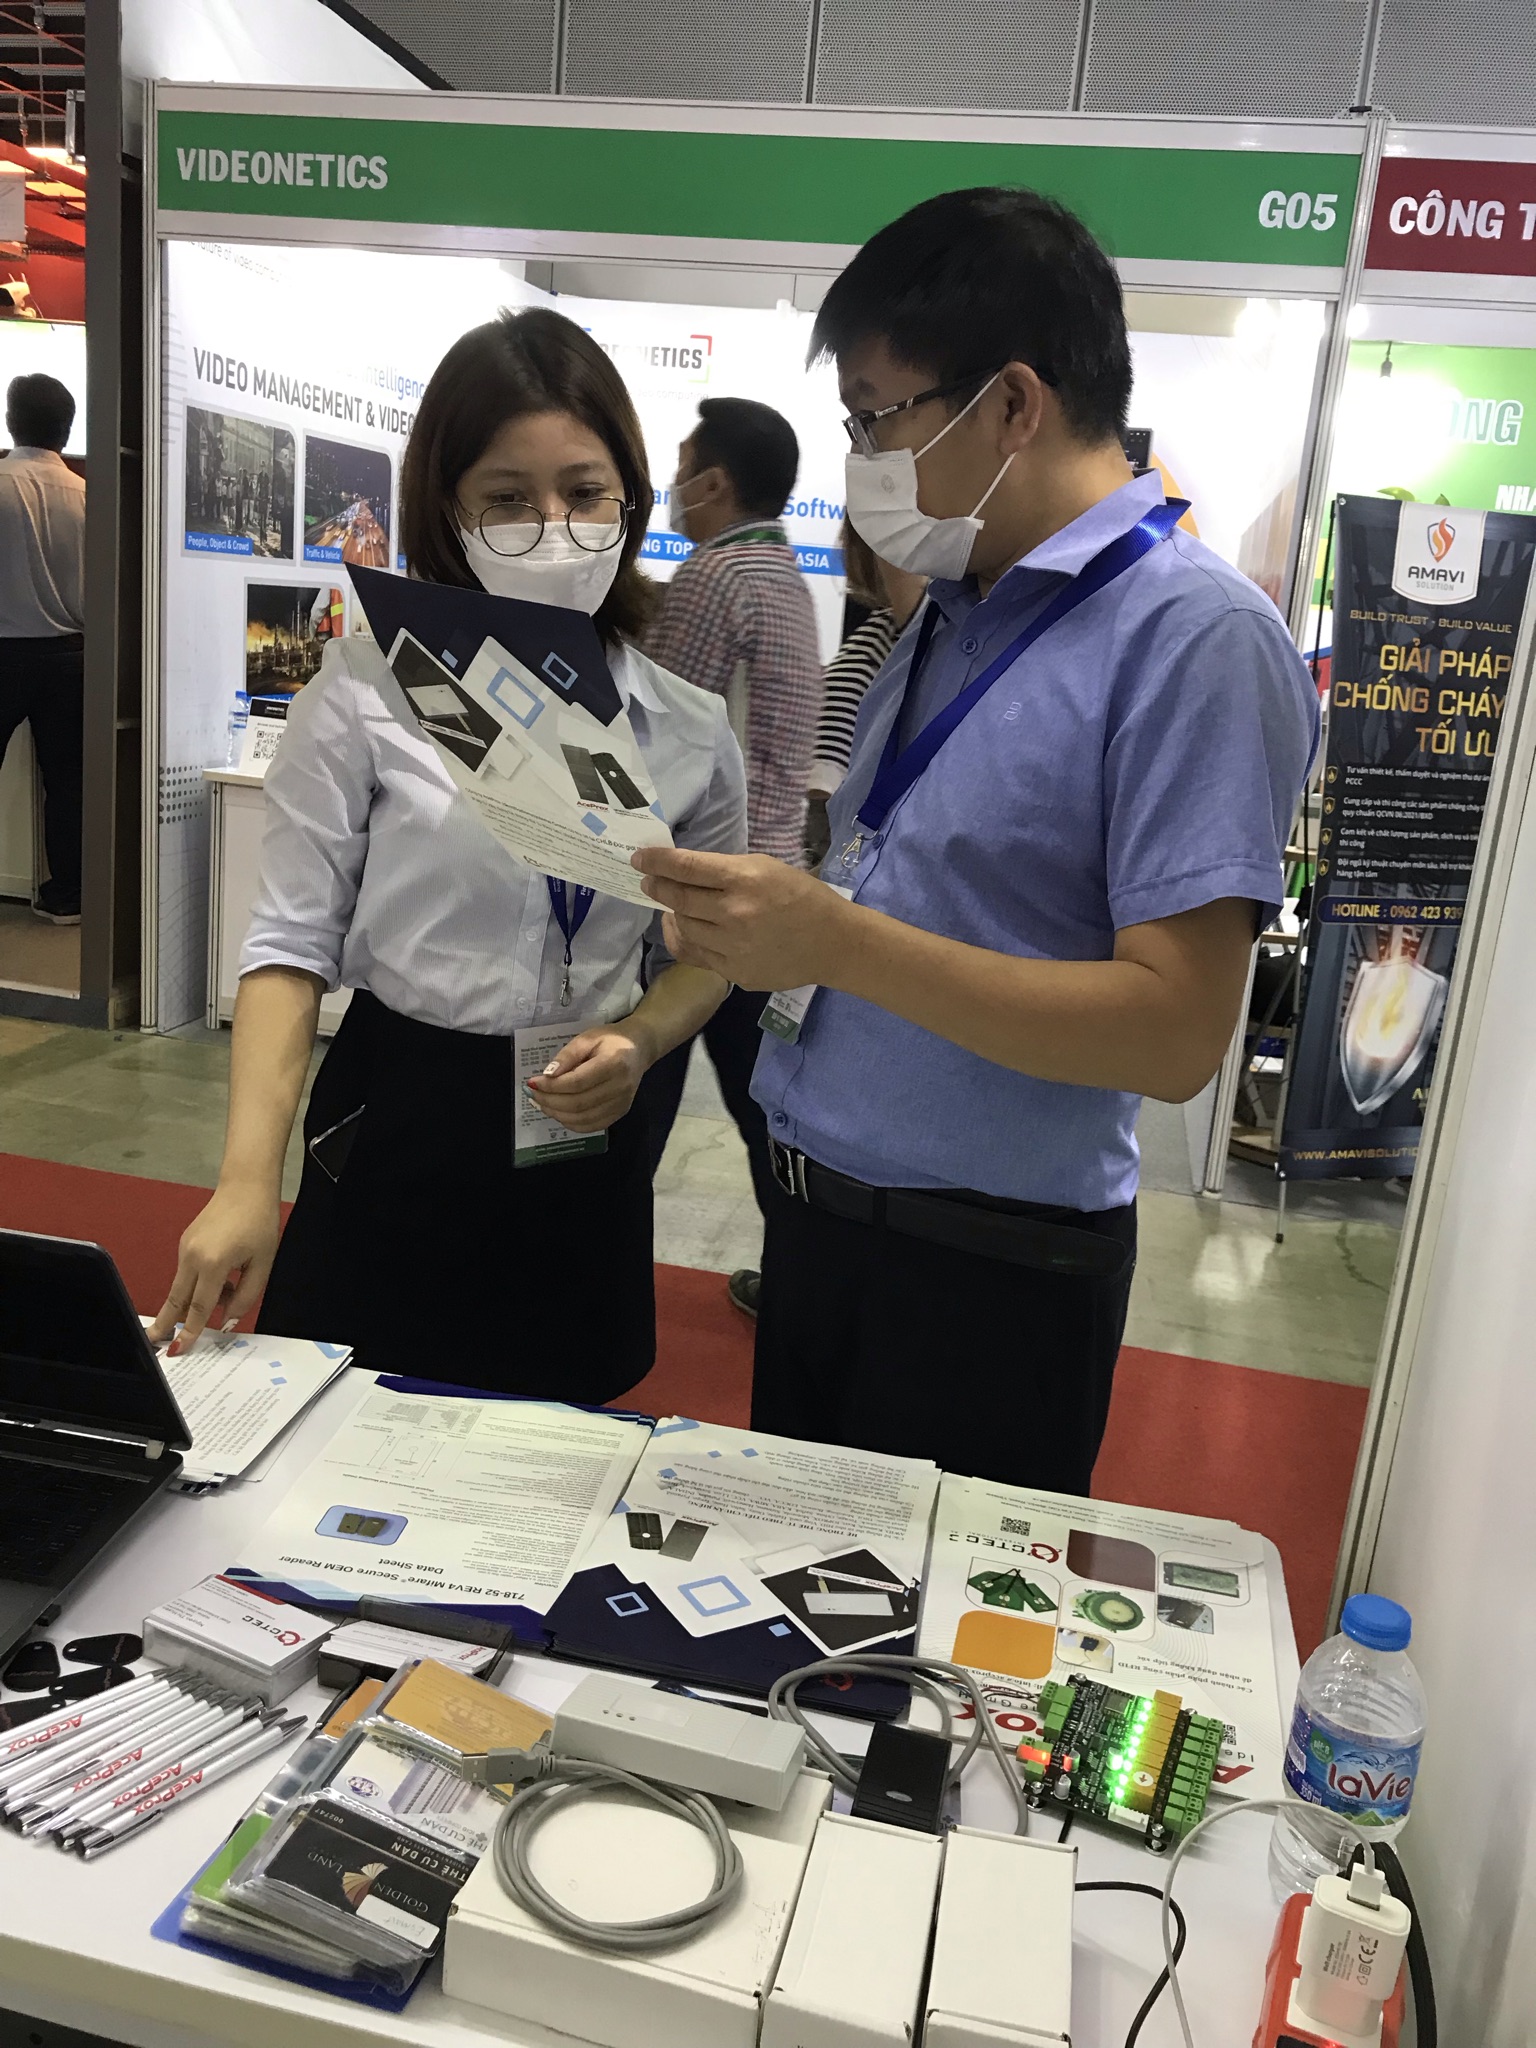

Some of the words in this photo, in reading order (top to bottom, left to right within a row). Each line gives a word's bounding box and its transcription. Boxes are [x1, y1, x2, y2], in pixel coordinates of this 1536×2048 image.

[177, 148, 388, 190] VIDEONETICS
[1390, 189, 1505, 240] CÔNG
[194, 347, 248, 393] VIDEO
[254, 367, 364, 425] MANAGEMENT
[366, 402, 376, 428] &
[366, 363, 428, 401] intelligenc
[783, 496, 845, 520] Softw
[210, 538, 227, 550] Object
[227, 540, 232, 550] &
[233, 541, 250, 551] Crowd
[665, 540, 694, 557] TOP
[796, 551, 829, 569] ASIA
[1408, 566, 1465, 584] AMAVI
[1416, 581, 1454, 591] SOLUTION
[1350, 609, 1387, 622] BUILD
[1390, 613, 1428, 626] TRUST
[1439, 618, 1473, 630] BUILD
[1475, 621, 1512, 633] VALUE
[1380, 638, 1430, 673] GIẢI
[1439, 646, 1512, 679] PHÁP
[1334, 674, 1429, 714] CHỐNG
[1438, 686, 1506, 719] CHÁY
[1415, 718, 1456, 755] TỐI
[1332, 904, 1380, 918] HOTLINE
[1390, 906, 1418, 919] 0962
[1420, 906, 1440, 919] 423
[966, 1535, 1025, 1553] CTEC
[278, 1555, 321, 1568] Reader
[323, 1563, 354, 1573] OEM
[377, 1557, 414, 1570] Sheet
[416, 1564, 444, 1575] Data
[356, 1568, 399, 1582] Secure
[448, 1583, 483, 1596] REV4
[485, 1588, 526, 1601] 718-52
[241, 1615, 282, 1635] CTEC
[7, 1714, 83, 1754] AceProx
[72, 1748, 143, 1793] AceProx
[110, 1763, 183, 1809] AceProx
[1328, 1763, 1411, 1801] laVie
[133, 1769, 203, 1817] AceProx
[1300, 1786, 1312, 1800] 350
[1312, 1795, 1322, 1806] ml
[420, 1817, 448, 1834] DÂN
[306, 1850, 343, 1873] LAND
[421, 1856, 438, 1868] CƯ
[441, 1865, 466, 1882] THẺ
[374, 1882, 429, 1913] GOLDEN
